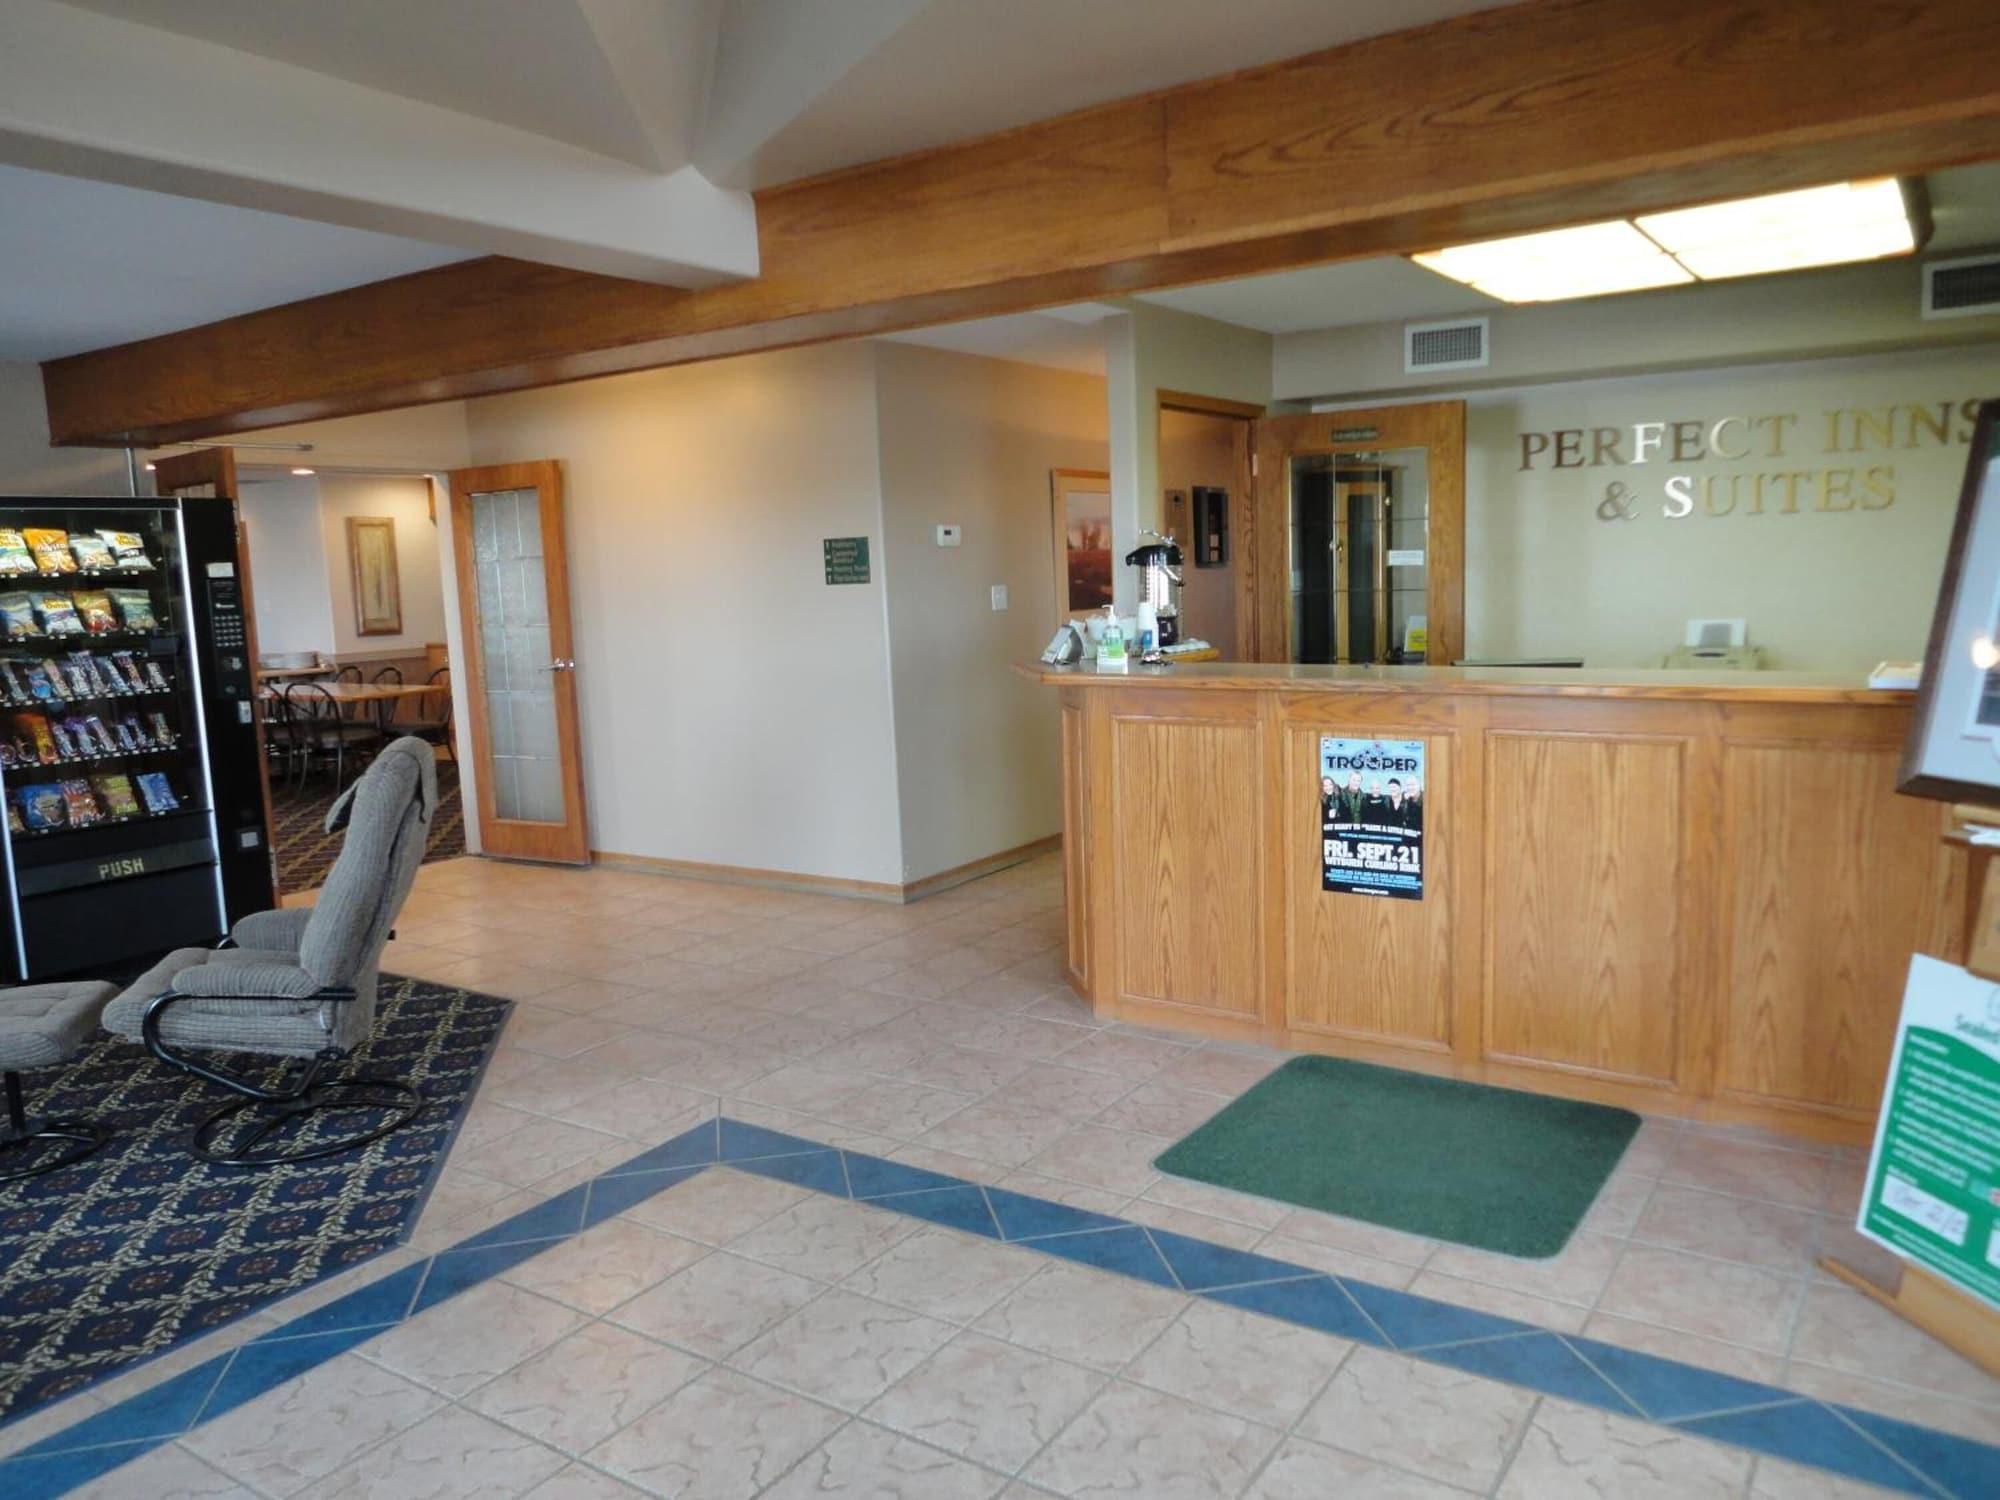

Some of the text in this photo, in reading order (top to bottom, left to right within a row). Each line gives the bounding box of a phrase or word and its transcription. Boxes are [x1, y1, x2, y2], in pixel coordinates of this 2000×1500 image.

[1519, 397, 1983, 472] PERFECT INNS
[1596, 464, 1897, 522] & SUITES
[1326, 756, 1418, 771] TROOPER
[1324, 840, 1354, 858] FRI.
[97, 857, 145, 879] PUSH
